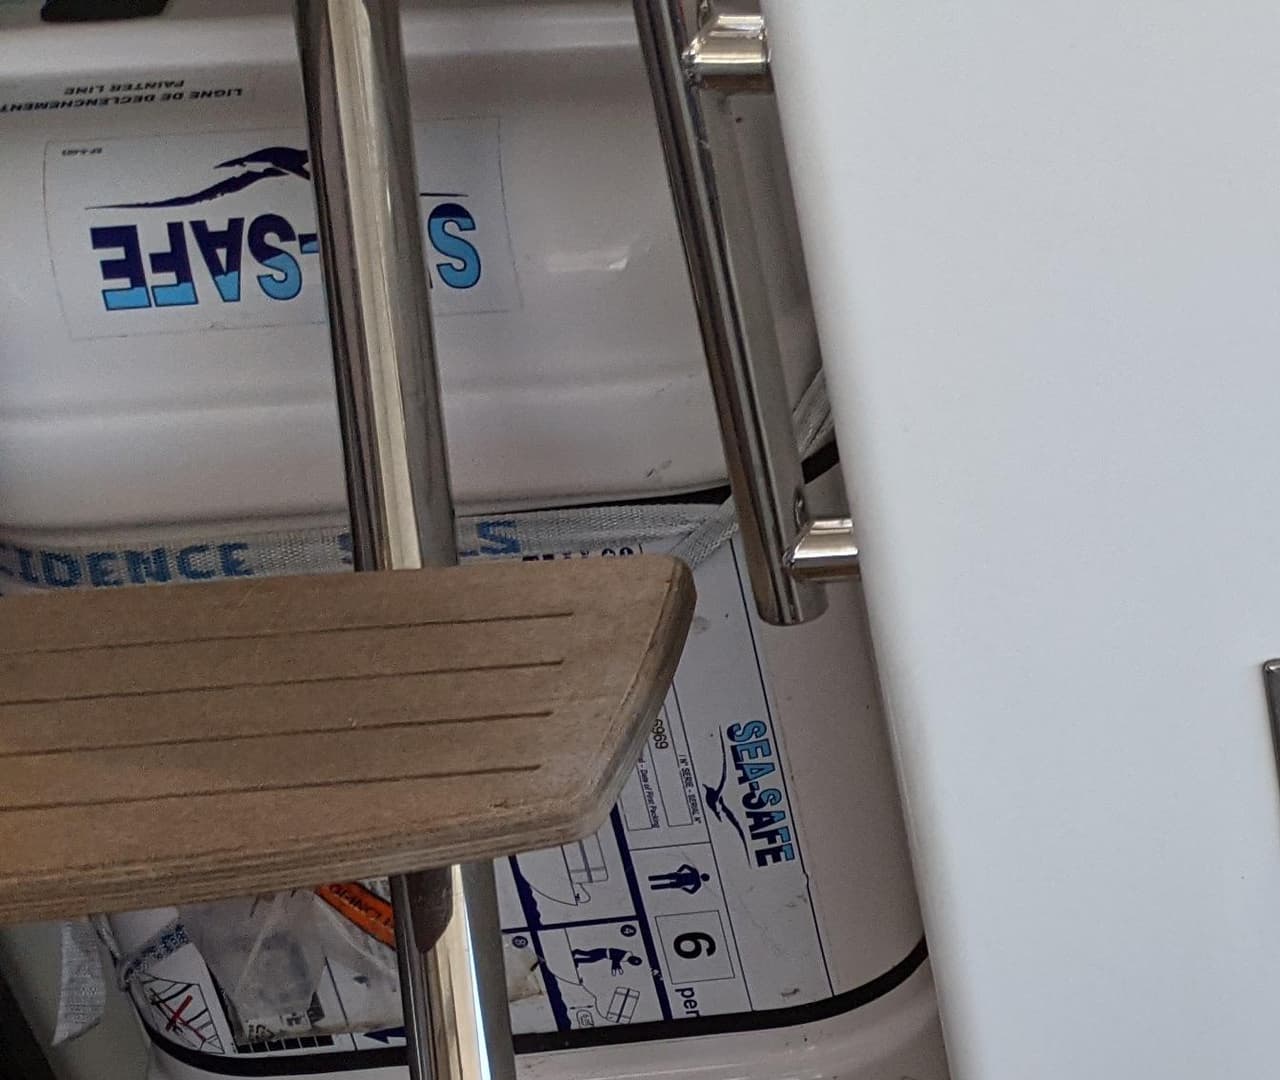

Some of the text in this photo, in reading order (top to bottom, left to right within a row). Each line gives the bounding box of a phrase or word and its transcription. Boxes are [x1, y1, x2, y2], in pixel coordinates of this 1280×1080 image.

[64, 80, 184, 95] PAINTER LINE
[189, 88, 243, 99] LIGNE
[161, 92, 184, 101] DE
[726, 720, 795, 867] SEA-SAFE
[673, 931, 717, 960] 6
